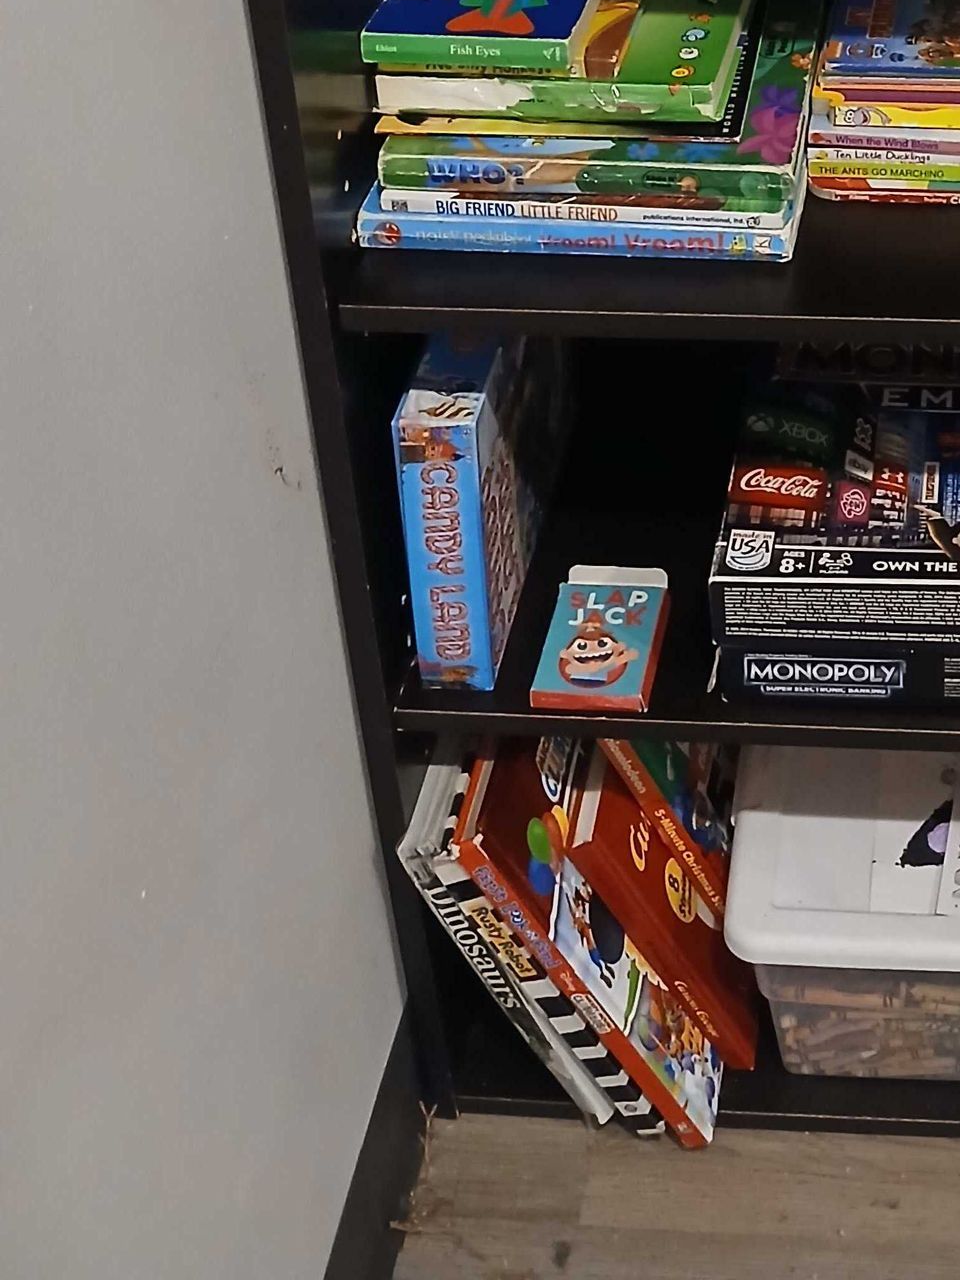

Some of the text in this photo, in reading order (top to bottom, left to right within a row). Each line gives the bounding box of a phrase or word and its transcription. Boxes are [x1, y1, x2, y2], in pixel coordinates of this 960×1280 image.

[450, 45, 501, 58] Fish Eyes
[836, 136, 939, 150] When the Wind Blows
[834, 150, 931, 164] Ten Little Ducklings
[427, 157, 525, 186] WHO?
[819, 166, 945, 178] THE ANTS GO MARCHING
[436, 200, 618, 222] BIG FRIEND LITTLE FRIEND
[643, 214, 685, 223] publications
[536, 232, 723, 251] Vroom! Vroom!
[779, 420, 830, 447] XBOX
[731, 538, 770, 555] USA
[779, 558, 806, 573] 8+
[873, 560, 919, 572] OWN
[923, 561, 958, 573] THE
[570, 588, 649, 610] SLAP
[568, 606, 647, 626] JACK
[750, 661, 896, 683] MONOPOLY
[766, 685, 887, 695] SUPER ELECTRONIC BANKING
[654, 808, 687, 852] 5-Minute
[682, 850, 714, 898] Christmas
[668, 873, 680, 893] 8
[424, 886, 521, 1009] Dinosaurs
[471, 907, 533, 974] Rusty Robot
